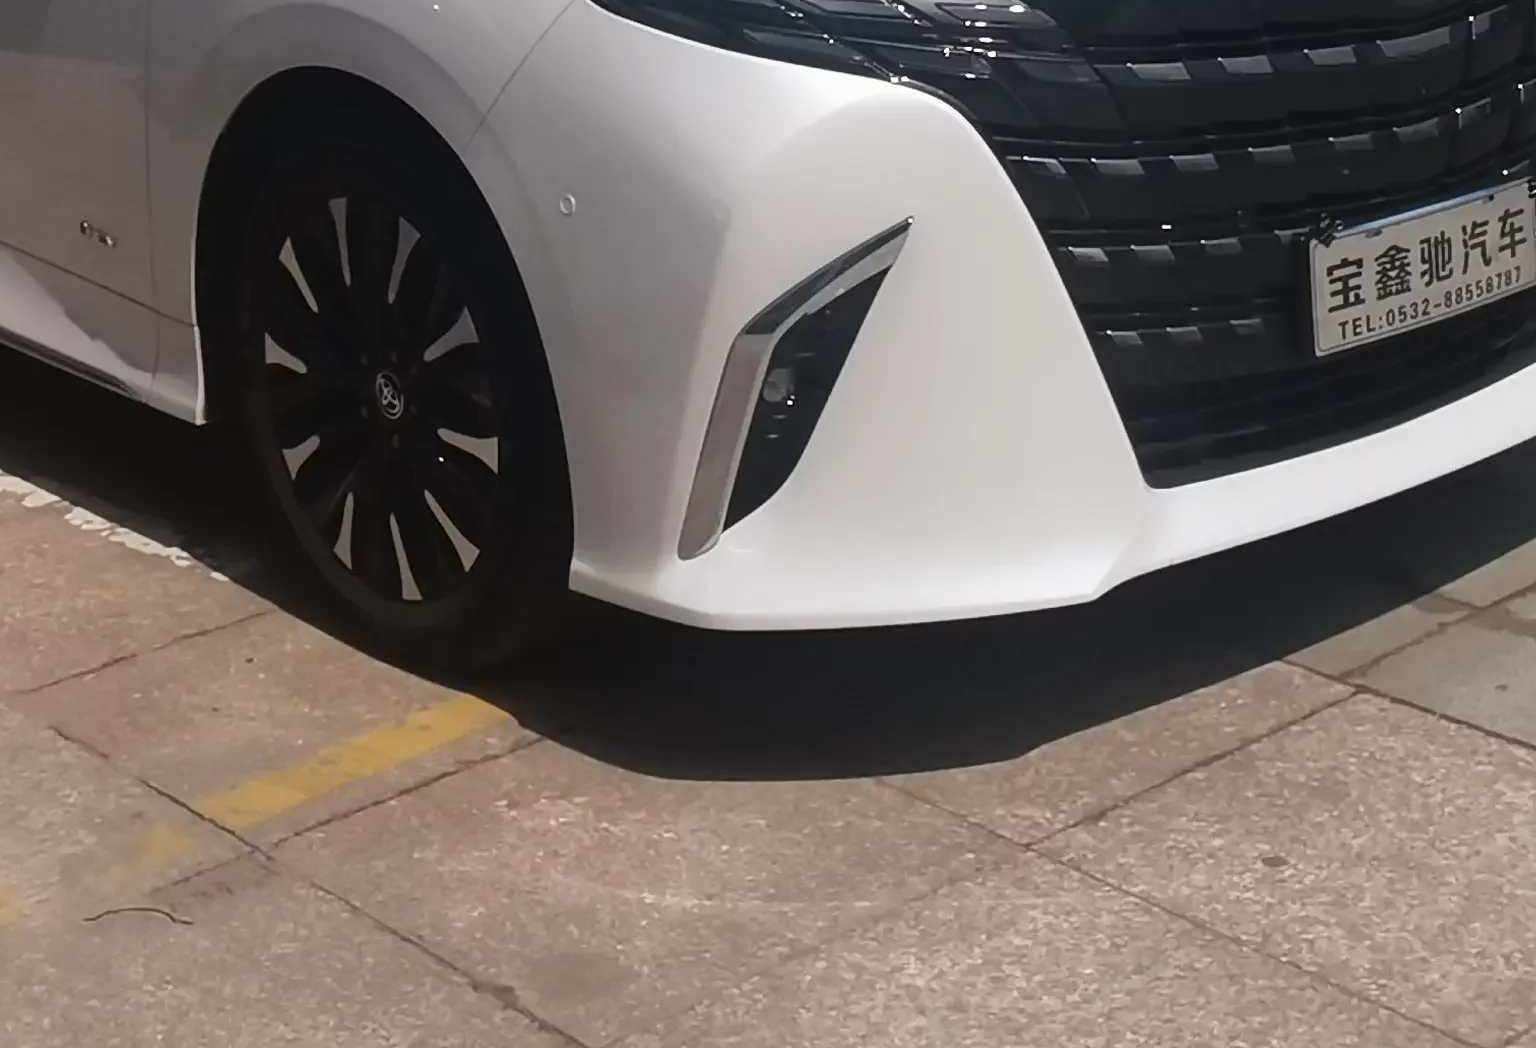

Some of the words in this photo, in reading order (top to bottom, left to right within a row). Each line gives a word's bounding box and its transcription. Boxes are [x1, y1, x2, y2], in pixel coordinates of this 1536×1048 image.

[1326, 208, 1528, 313] 宝鑫驰汽车
[1337, 265, 1522, 341] TEL:0532-88558787
